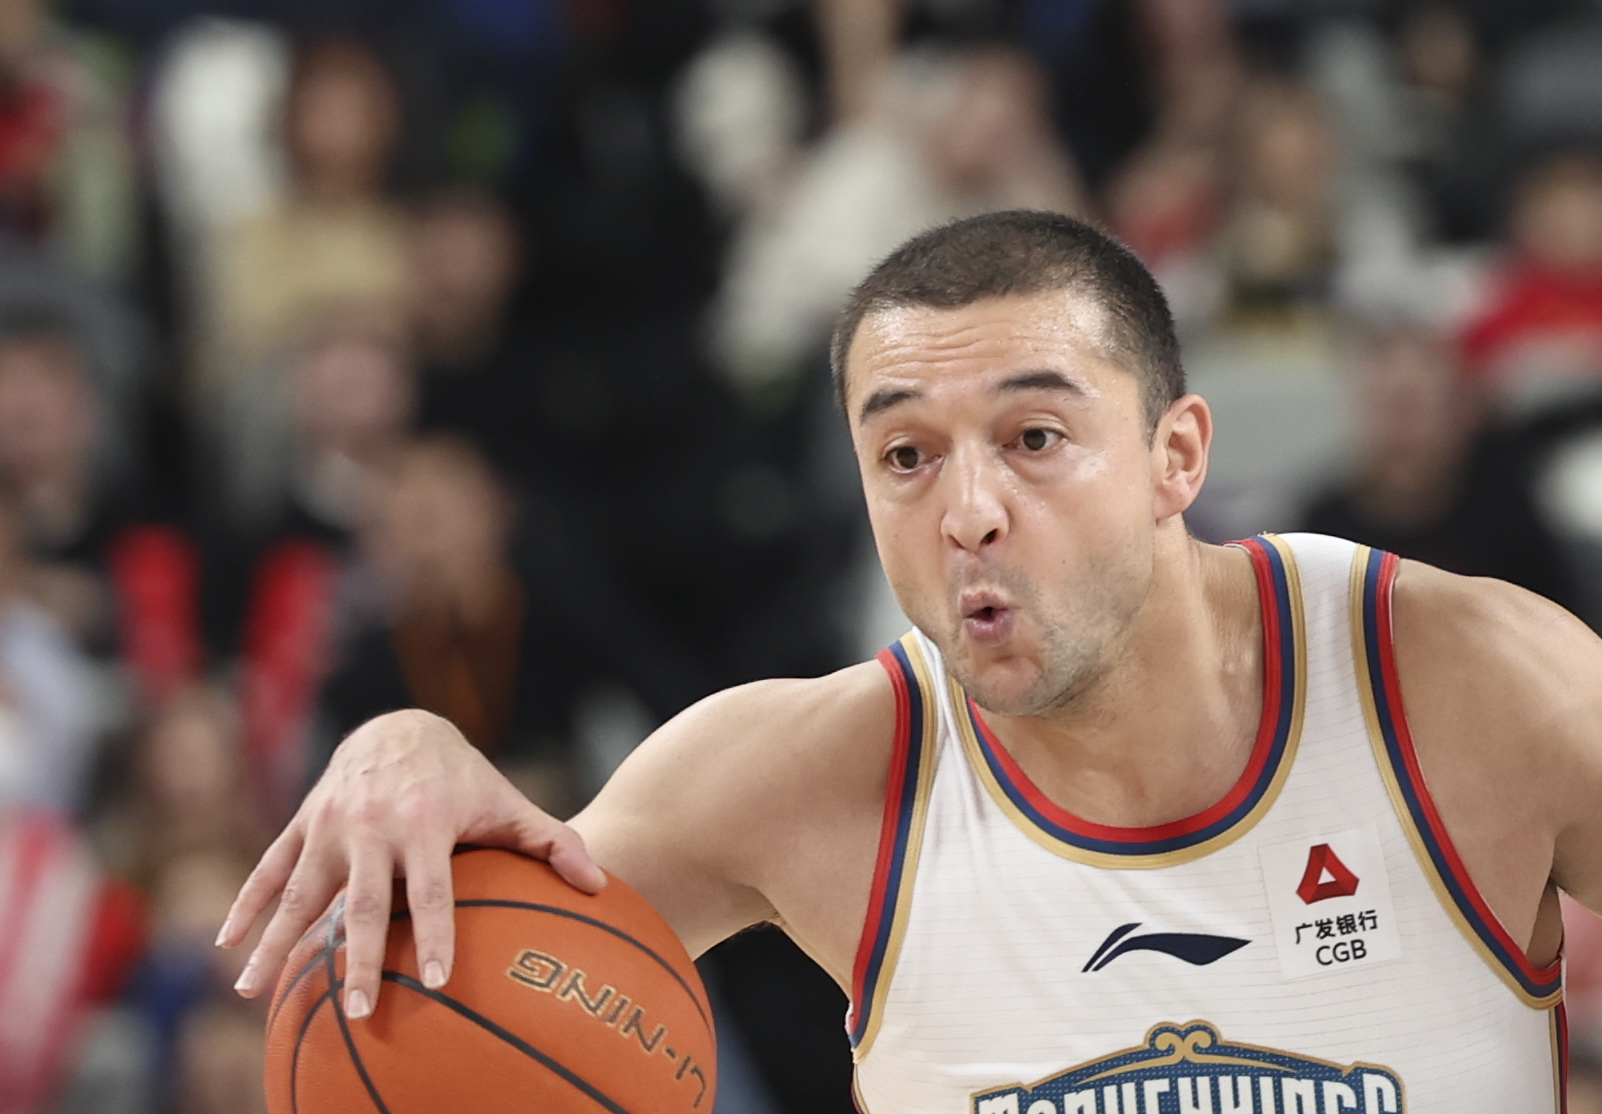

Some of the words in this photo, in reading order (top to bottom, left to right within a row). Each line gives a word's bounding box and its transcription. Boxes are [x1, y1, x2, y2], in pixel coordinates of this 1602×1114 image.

[1295, 908, 1378, 944] 广发银行
[1316, 938, 1367, 966] CGB
[506, 949, 707, 1110] LI-NING
